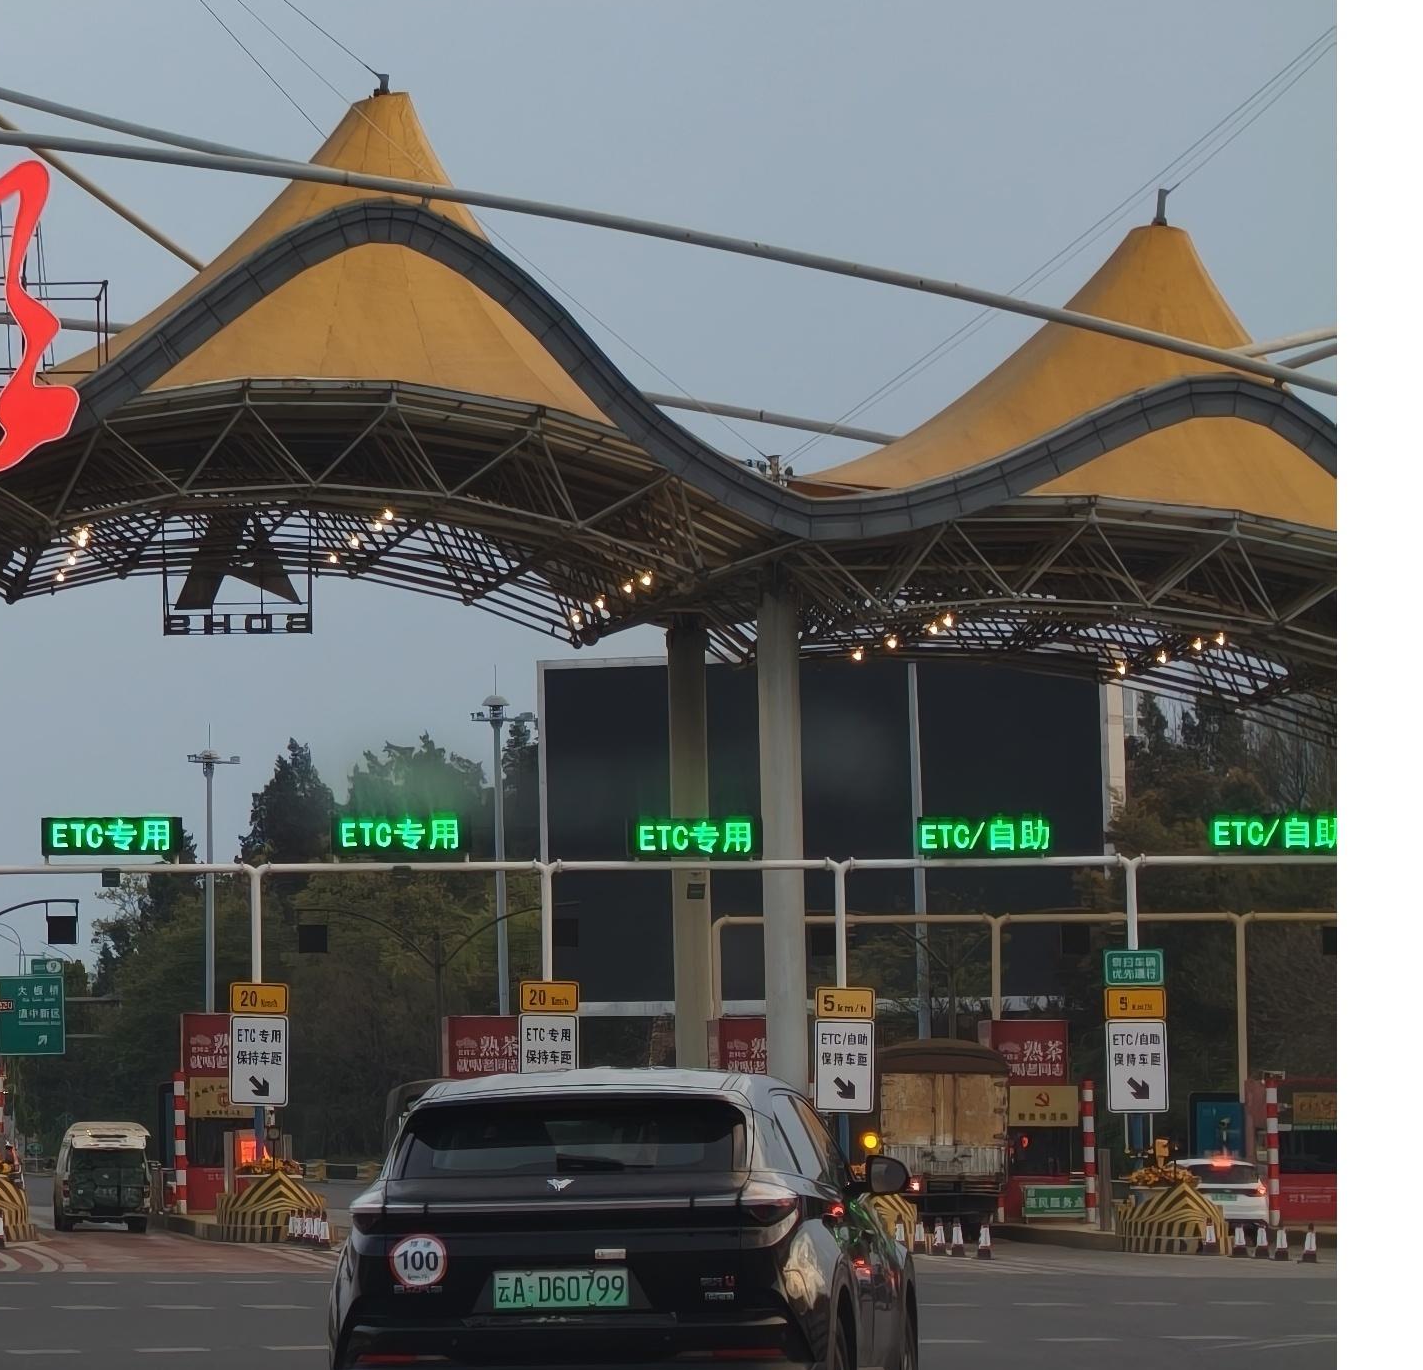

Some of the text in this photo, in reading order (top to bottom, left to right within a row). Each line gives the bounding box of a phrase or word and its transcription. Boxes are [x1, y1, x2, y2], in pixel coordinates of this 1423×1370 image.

[51, 818, 171, 850] ETC专用
[340, 819, 459, 849] ETC专用
[638, 821, 752, 853] ETC专用
[920, 820, 1050, 851] ETC/自助
[240, 990, 257, 1007] 20
[529, 989, 546, 1005] 20
[823, 995, 867, 1013] 5 km/h
[237, 1029, 282, 1043] ETC 专用
[526, 1028, 571, 1041] ETC 专用
[821, 1033, 868, 1046] ETC/自助
[1112, 1033, 1160, 1046] ETC/自助
[397, 1250, 439, 1272] 100
